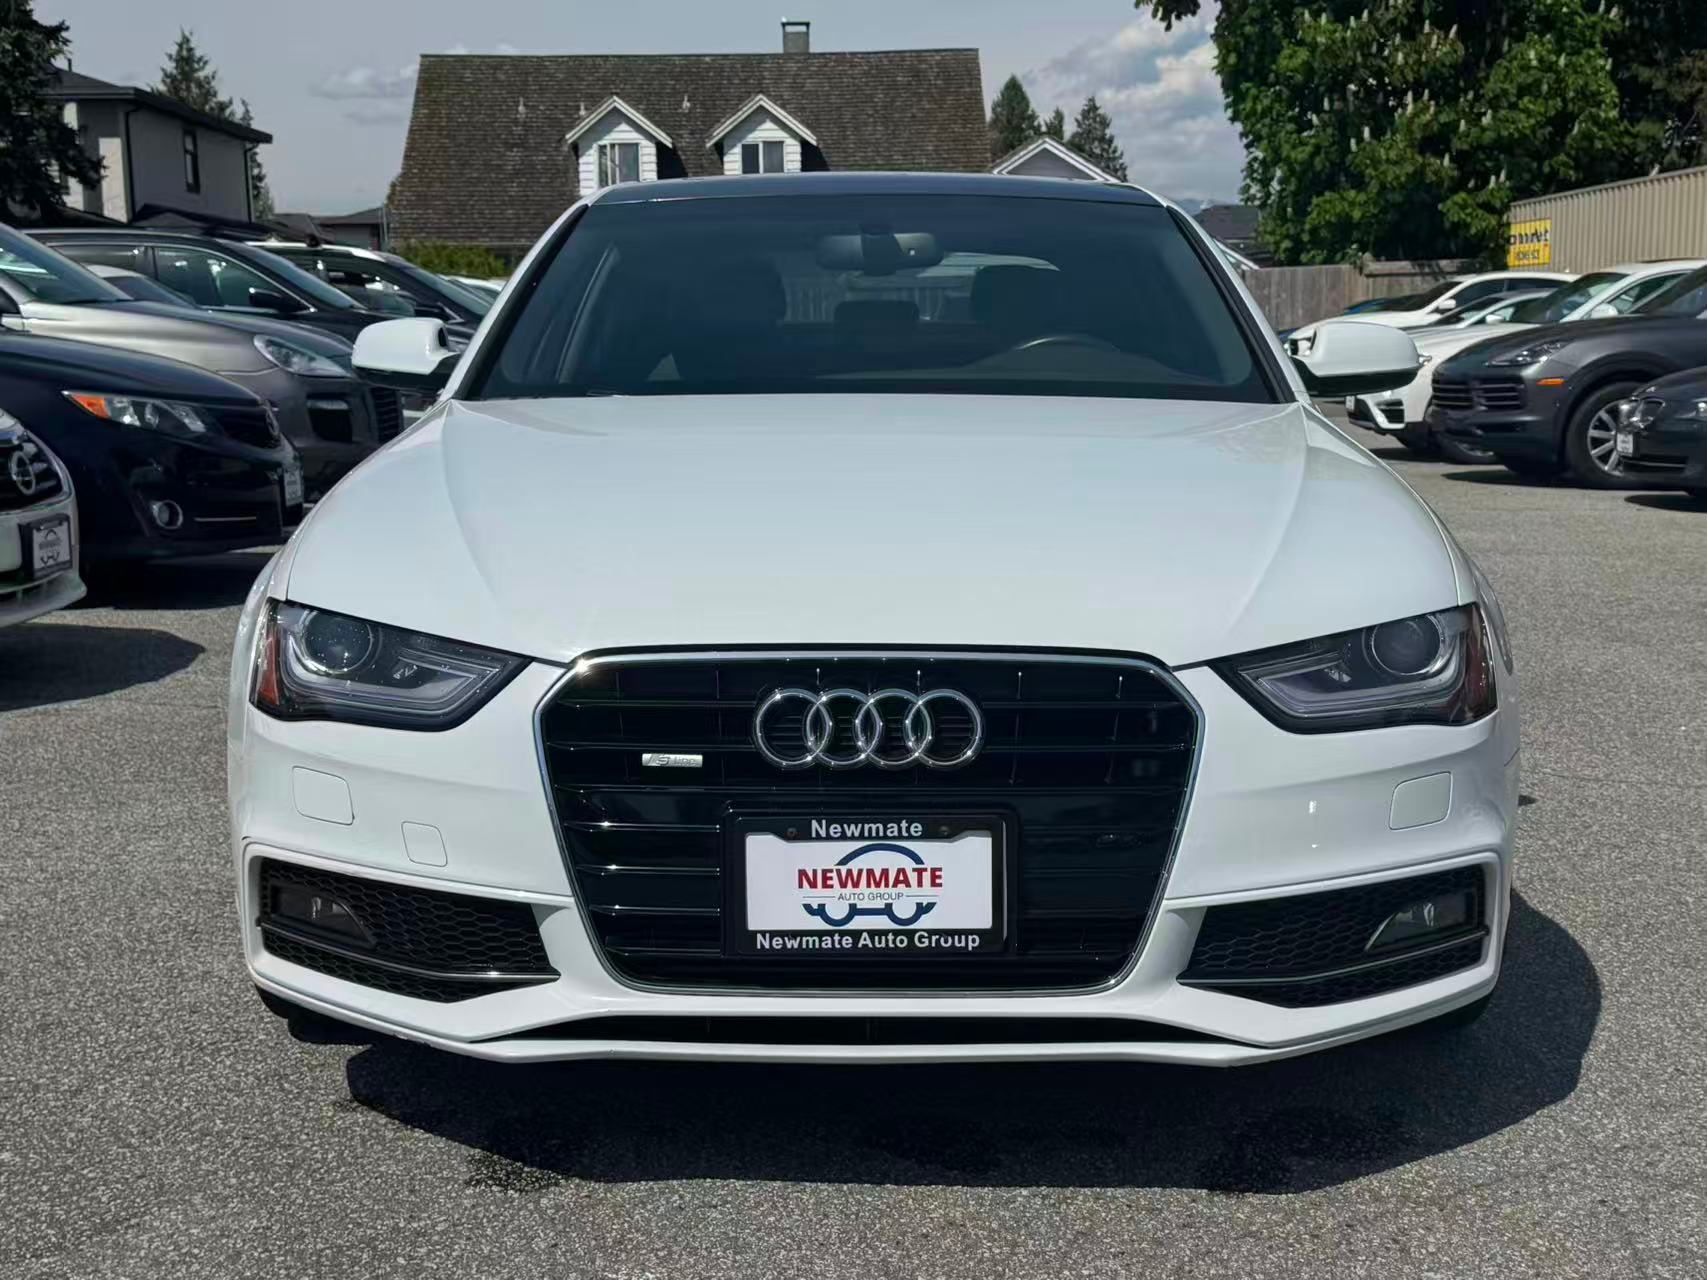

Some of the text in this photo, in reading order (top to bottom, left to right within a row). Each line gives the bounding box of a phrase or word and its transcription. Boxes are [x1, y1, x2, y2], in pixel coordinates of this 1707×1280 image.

[810, 819, 923, 838] Newmate
[797, 867, 943, 889] NEWMATE
[837, 892, 904, 901] AUTO GROUP
[756, 931, 980, 950] Newmate Auto Group
